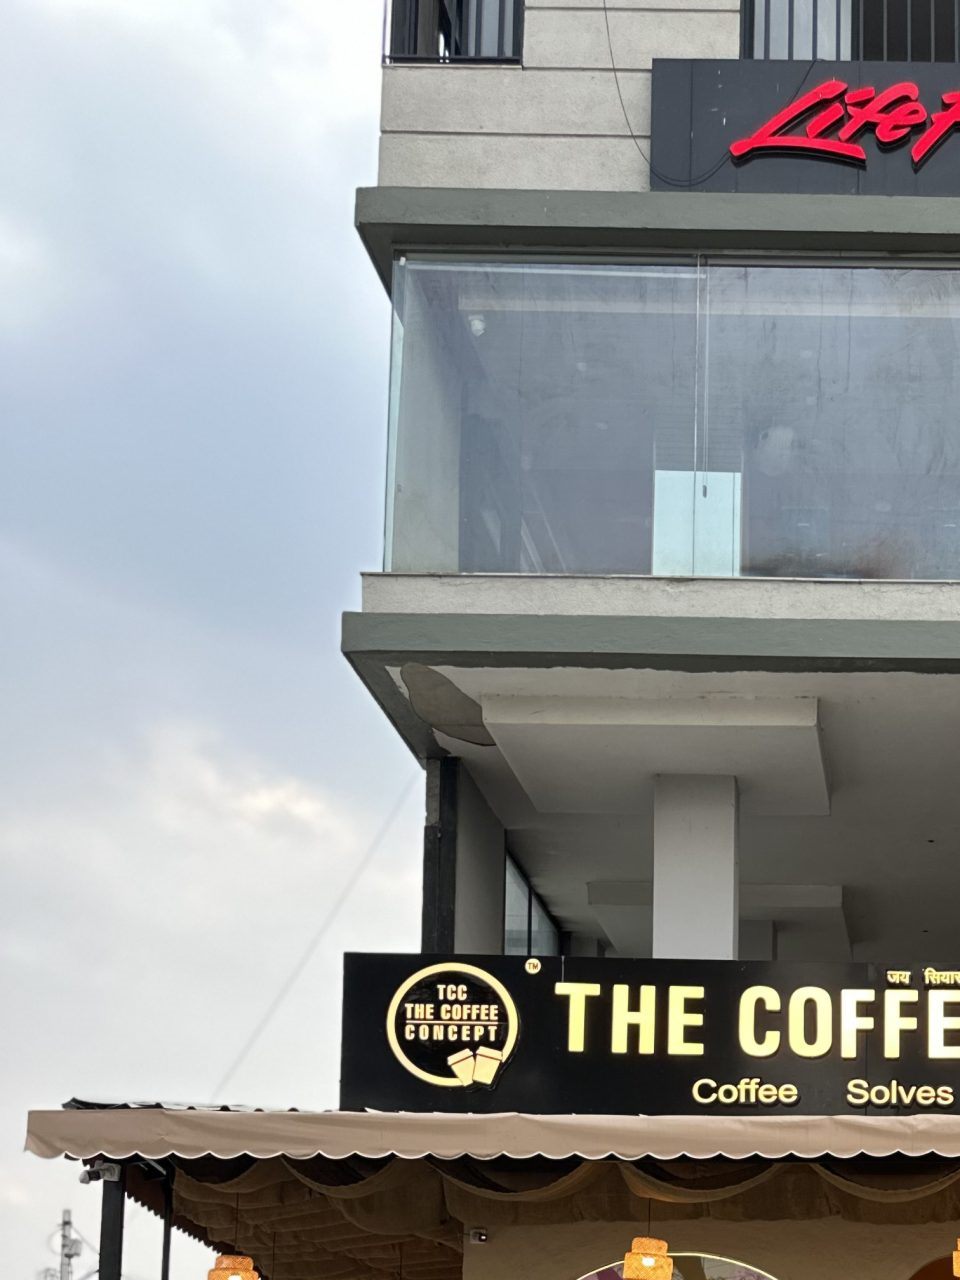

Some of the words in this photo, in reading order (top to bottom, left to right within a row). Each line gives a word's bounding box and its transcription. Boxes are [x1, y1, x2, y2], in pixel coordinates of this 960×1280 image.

[886, 970, 912, 985] जय
[436, 984, 468, 1001] TCC
[404, 1003, 435, 1020] THE
[440, 1003, 499, 1021] COFFEE
[554, 982, 705, 1055] THE
[404, 1024, 498, 1042] CONCEPT
[692, 1077, 799, 1105] Coffee
[846, 1078, 955, 1106] Solves
